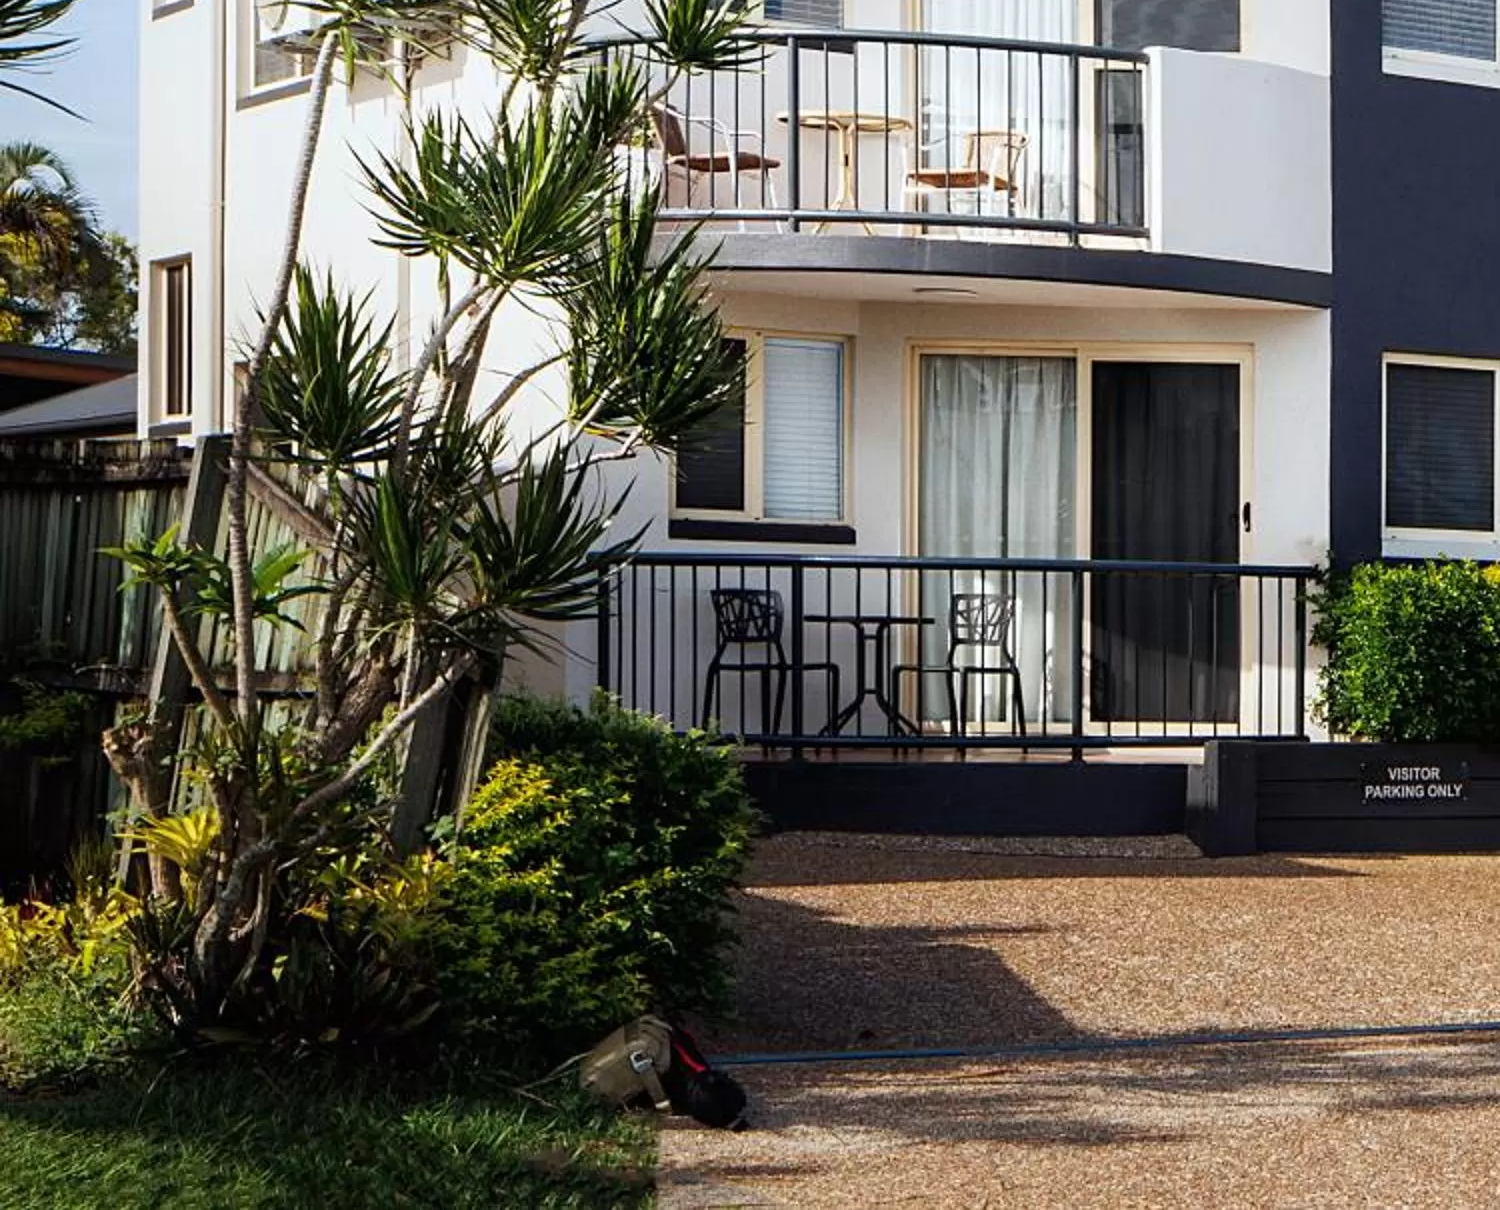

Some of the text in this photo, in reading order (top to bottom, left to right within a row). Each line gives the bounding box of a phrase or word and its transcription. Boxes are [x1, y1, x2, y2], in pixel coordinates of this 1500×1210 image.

[1387, 766, 1441, 781] VISITOR
[1364, 783, 1463, 799] PARKING ONLY
